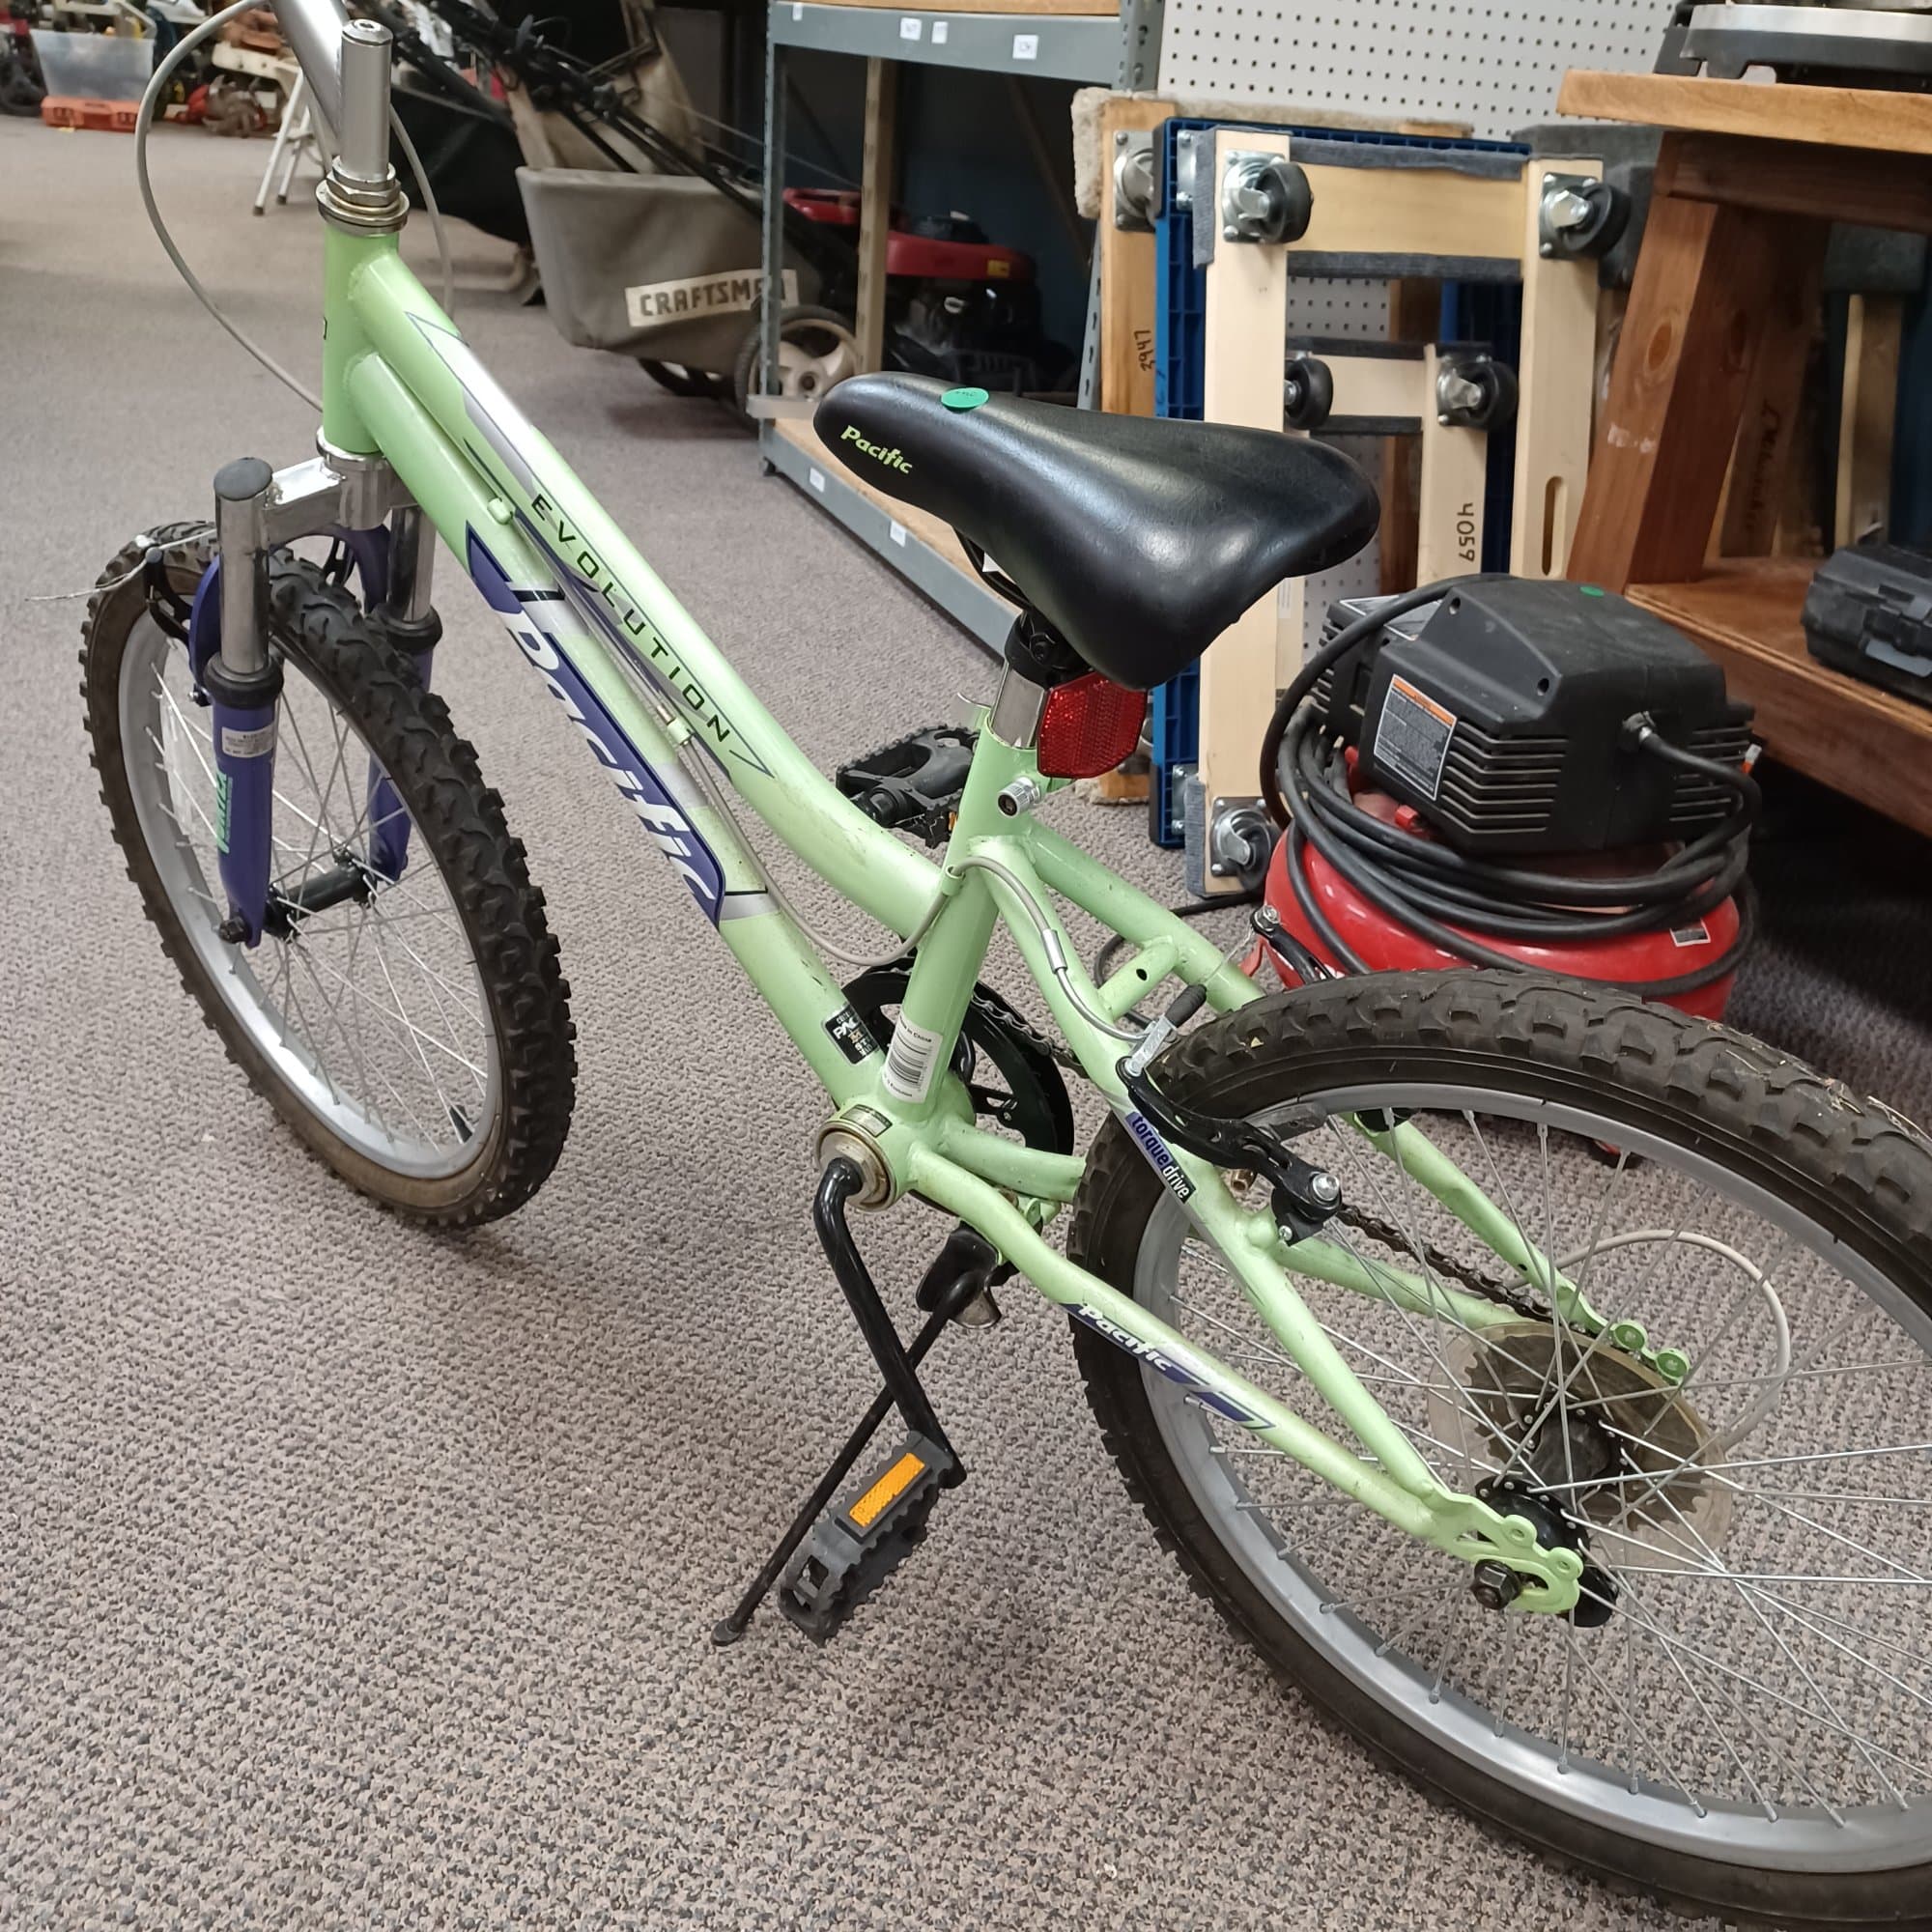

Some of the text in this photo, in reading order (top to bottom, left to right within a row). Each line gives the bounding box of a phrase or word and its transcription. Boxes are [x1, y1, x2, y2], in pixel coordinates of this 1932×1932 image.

[639, 277, 785, 317] CRAFTSM
[840, 424, 913, 474] Pacific
[1457, 502, 1475, 563] 4059
[531, 494, 730, 743] EVOLUTION
[1078, 1304, 1172, 1372] Pacific
